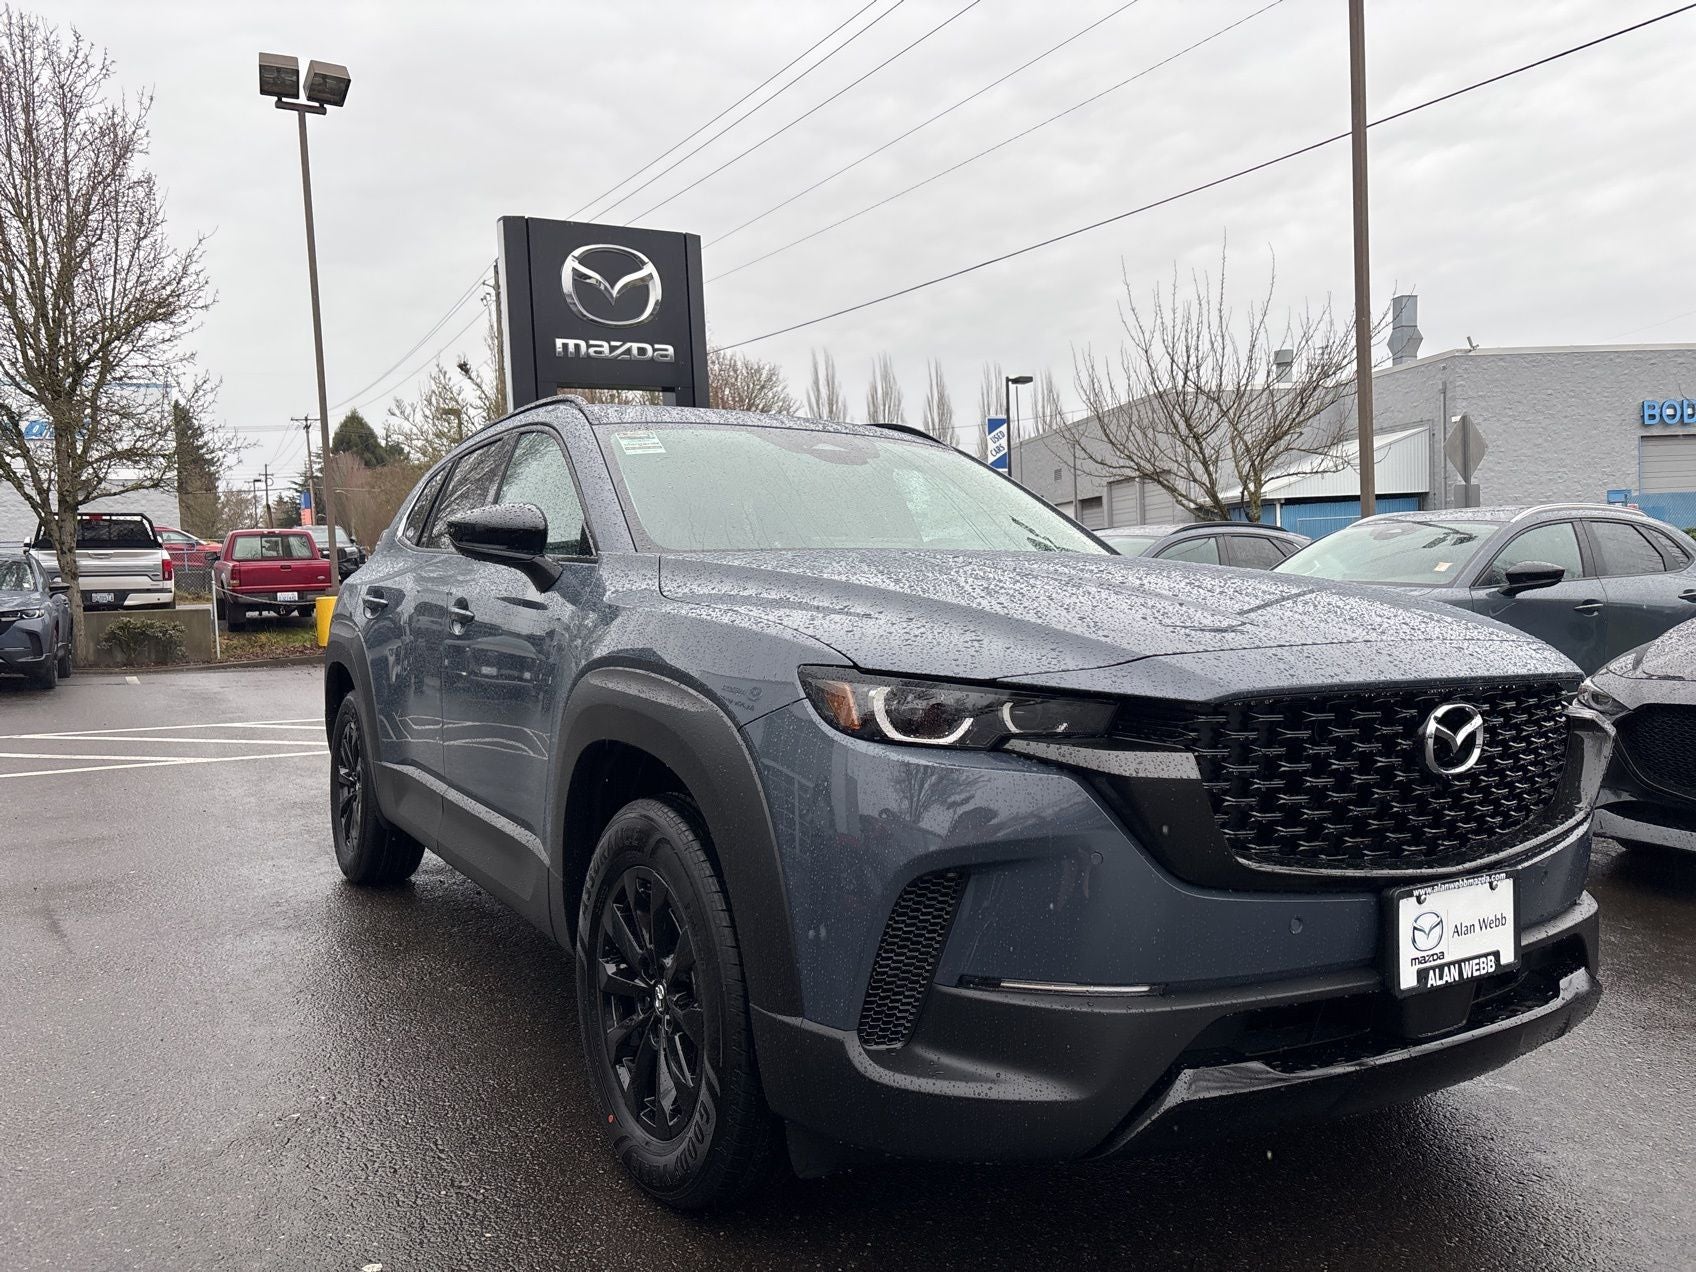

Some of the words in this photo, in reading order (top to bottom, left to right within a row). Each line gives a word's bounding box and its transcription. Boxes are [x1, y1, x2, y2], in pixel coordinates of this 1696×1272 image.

[1641, 399, 1696, 425] BOD
[989, 430, 1005, 444] USED
[990, 443, 1005, 456] CARS
[1413, 873, 1506, 897] www.alanwebbmazda.com
[1452, 922, 1476, 938] Alan
[1478, 913, 1507, 931] Webb
[1427, 963, 1459, 988] ALAN
[1461, 955, 1496, 979] WEBB
